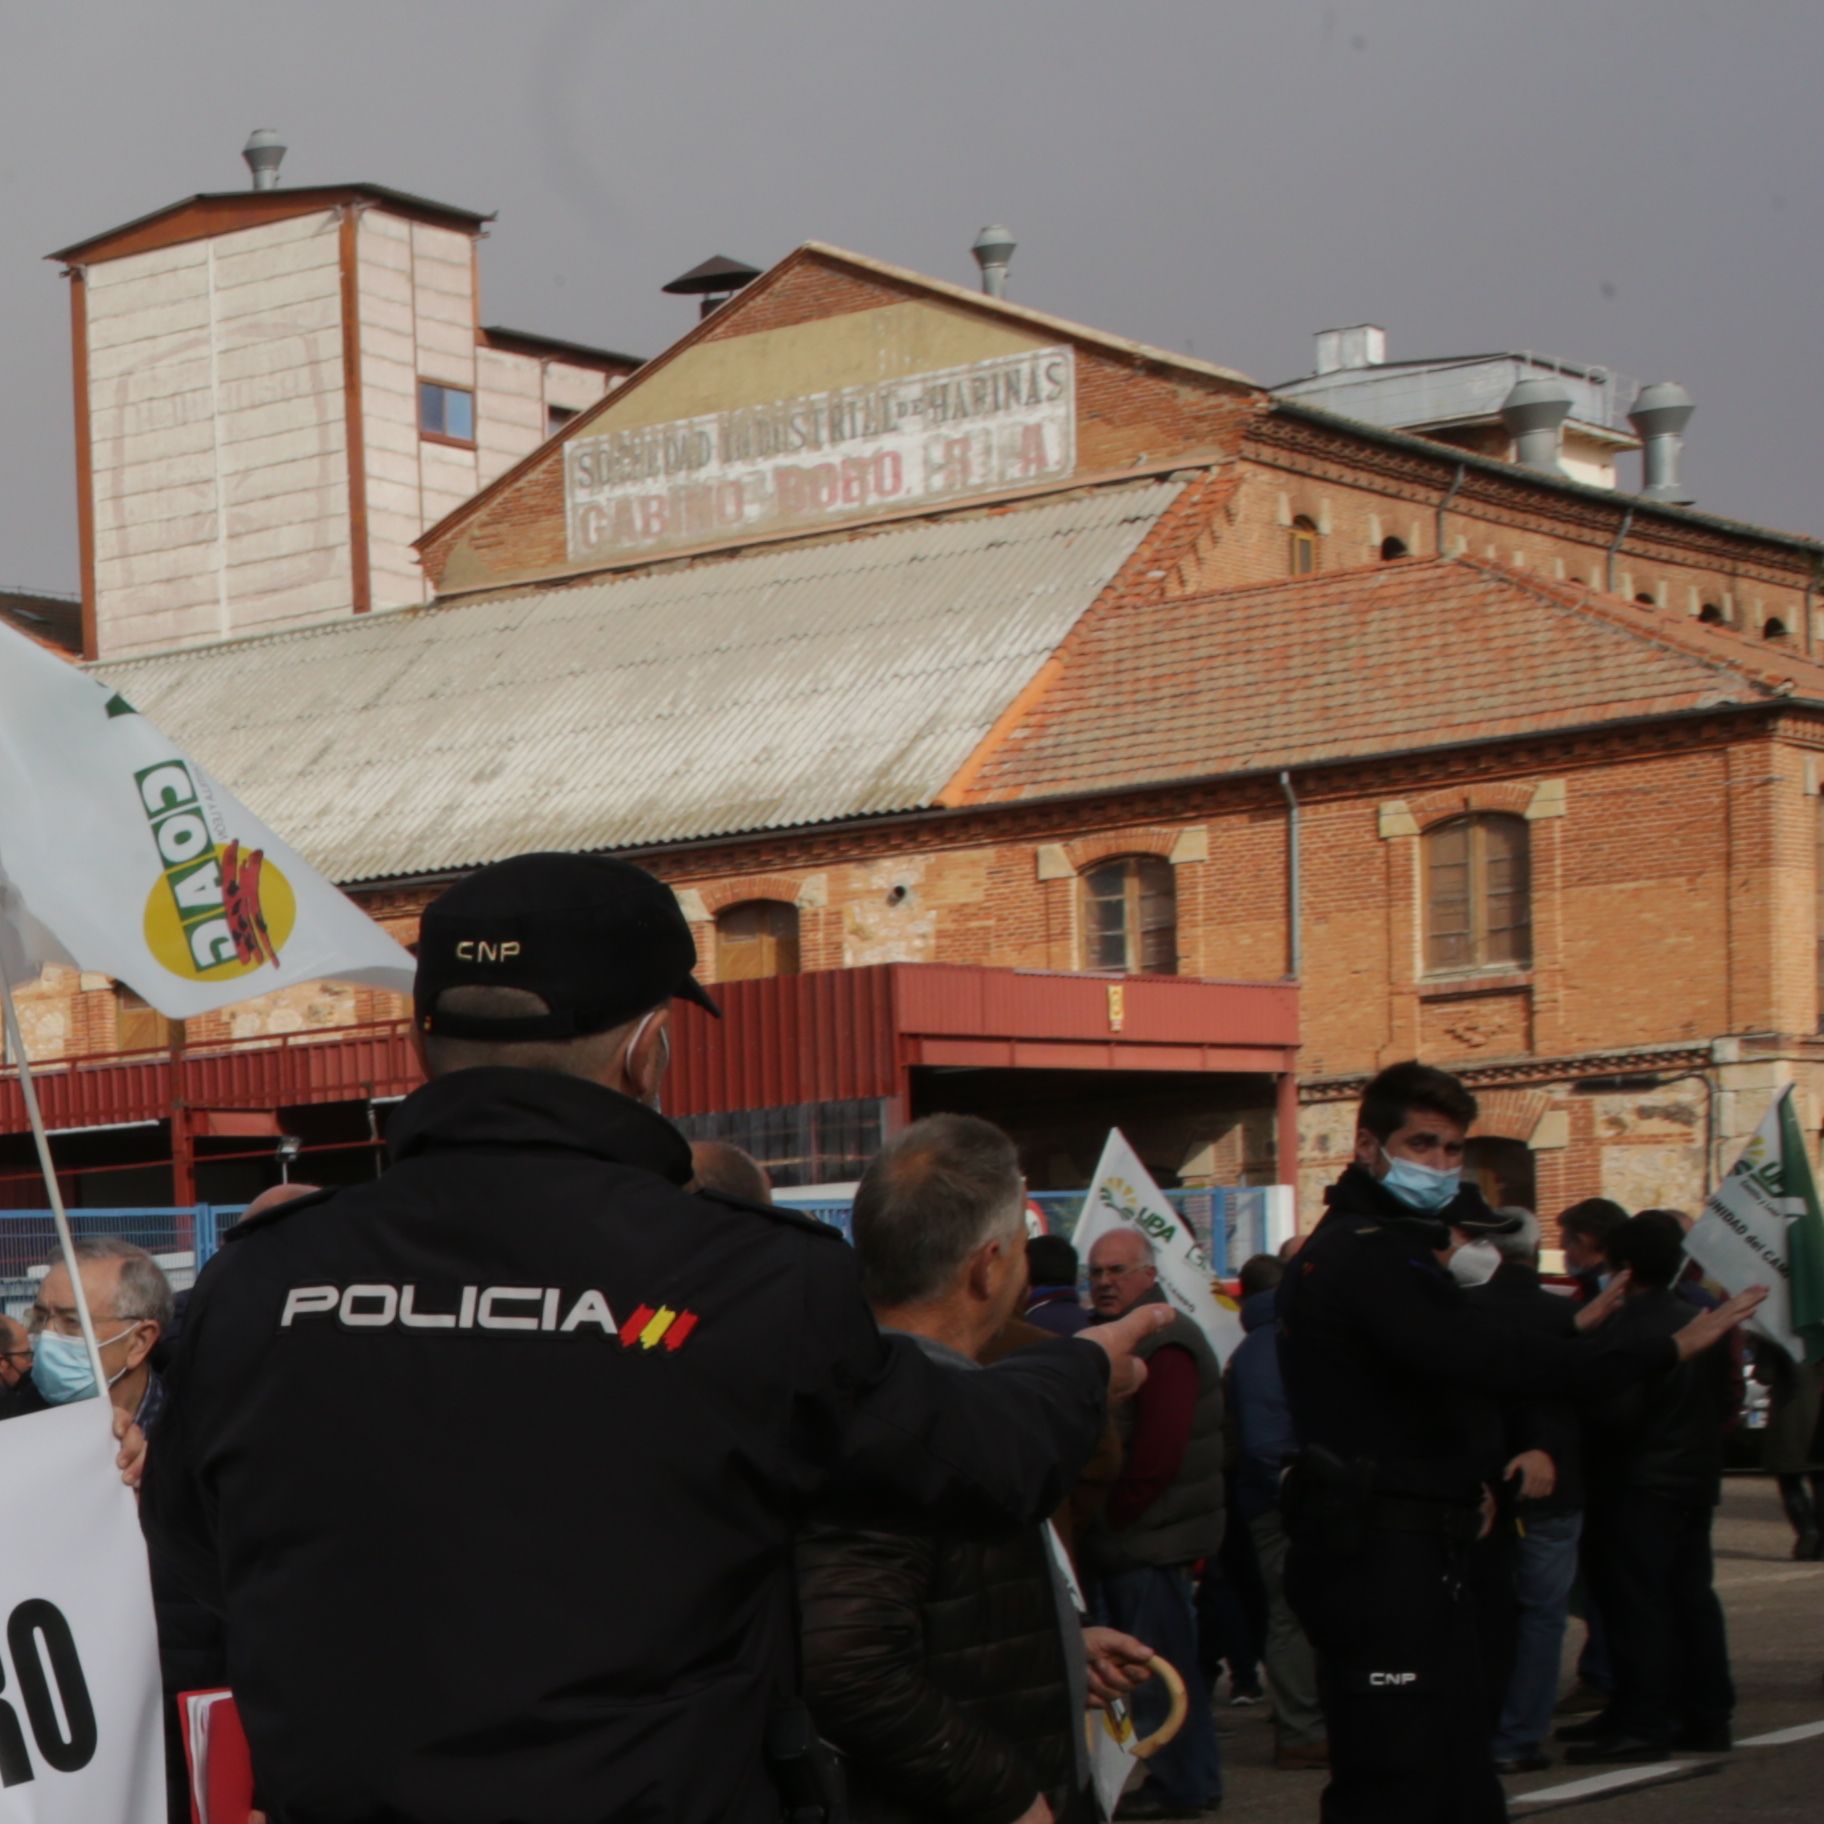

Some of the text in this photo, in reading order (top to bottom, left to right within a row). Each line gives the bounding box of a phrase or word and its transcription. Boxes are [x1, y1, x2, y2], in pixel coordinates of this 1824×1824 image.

[456, 940, 521, 963] CNP
[1137, 1207, 1177, 1246] UPA
[280, 1283, 619, 1336] POLICIA
[1369, 1671, 1417, 1687] CNP
